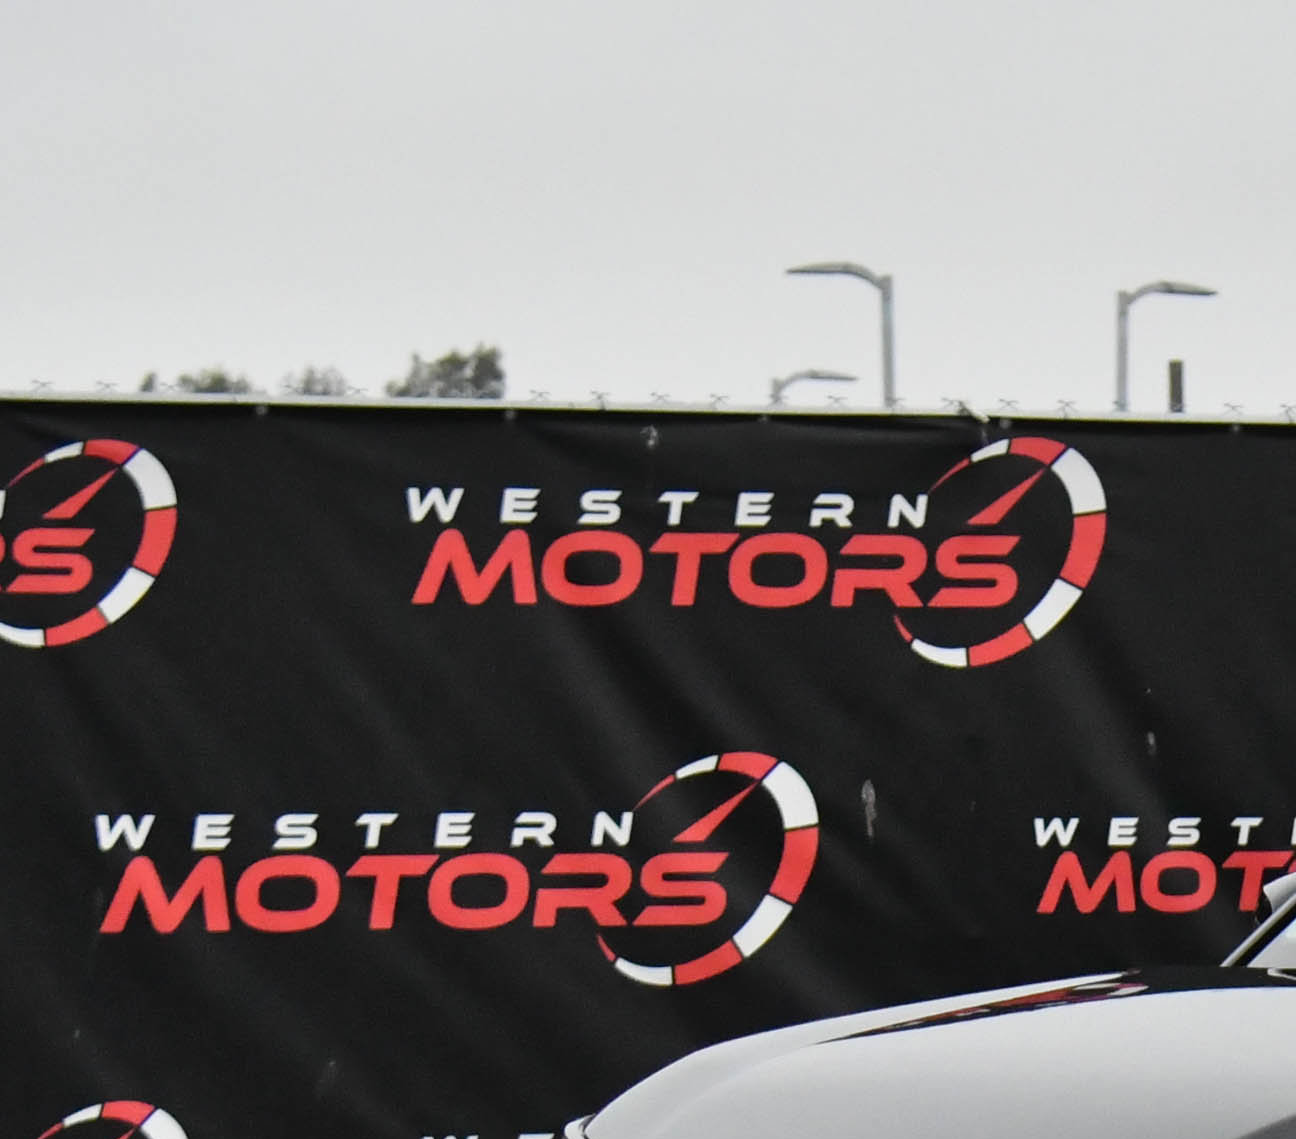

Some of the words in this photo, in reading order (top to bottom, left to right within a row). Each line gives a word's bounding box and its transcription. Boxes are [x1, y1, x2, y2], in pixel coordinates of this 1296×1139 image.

[407, 487, 929, 528] WESTERN
[411, 528, 1021, 609] MOTORS
[95, 811, 634, 851] WESTERN
[99, 851, 729, 935] MOTORS
